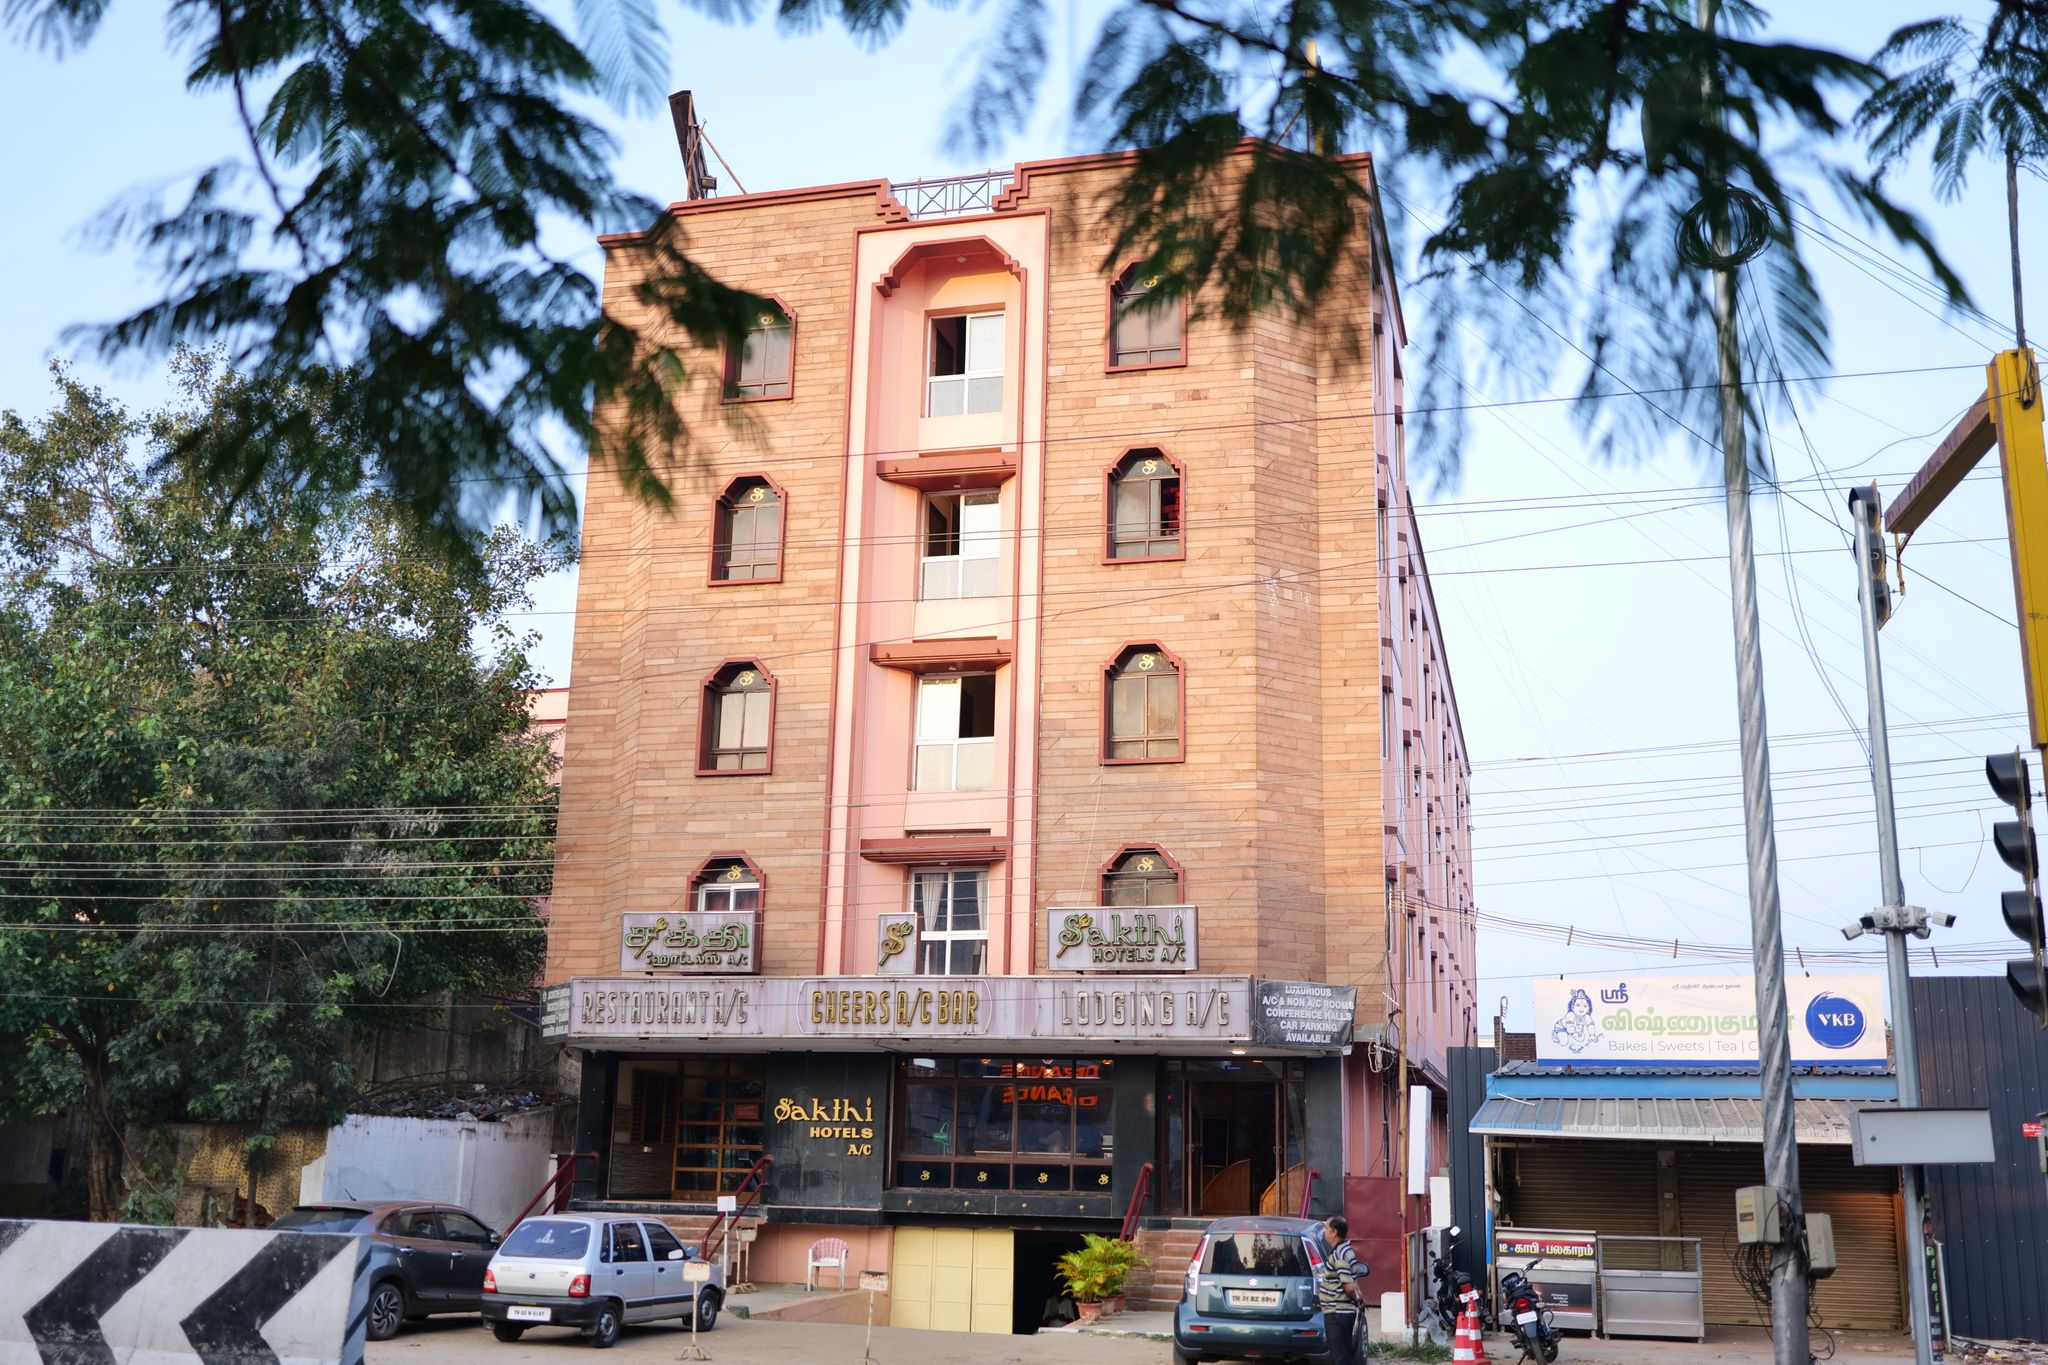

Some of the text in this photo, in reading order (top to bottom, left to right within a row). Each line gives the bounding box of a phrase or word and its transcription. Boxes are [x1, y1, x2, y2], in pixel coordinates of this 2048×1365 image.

[623, 917, 749, 956] சக்தி
[1057, 913, 1187, 957] Sakthi
[727, 953, 750, 967] A/C
[1092, 947, 1187, 964] HOTELS A/C
[1285, 985, 1332, 998] LUXURIOUS
[582, 991, 710, 1024] RESTAURANT
[713, 988, 748, 1027] A/C
[811, 987, 979, 1027] CHEERS A/C BAR
[1061, 988, 1230, 1029] LODGING A/C
[1262, 995, 1278, 1006] A/C
[1287, 998, 1305, 1008] NON
[1308, 999, 1322, 1009] A/C
[1324, 1000, 1355, 1010] ROOMS
[1266, 1007, 1353, 1021] CONFERENCE HALLS
[1817, 1013, 1856, 1027] VKB
[1280, 1020, 1338, 1033] CAR PARKING
[1285, 1032, 1332, 1044] AVAILABLE
[1608, 1040, 1648, 1052] Bakes
[1657, 1040, 1705, 1052] Sweets
[1714, 1040, 1738, 1052] Tea
[774, 1096, 874, 1123] Sakthi
[809, 1127, 873, 1139] HOTELS
[847, 1143, 872, 1157] A/C
[1515, 1242, 1540, 1254] காபி
[1546, 1244, 1594, 1257] பலகாரம்
